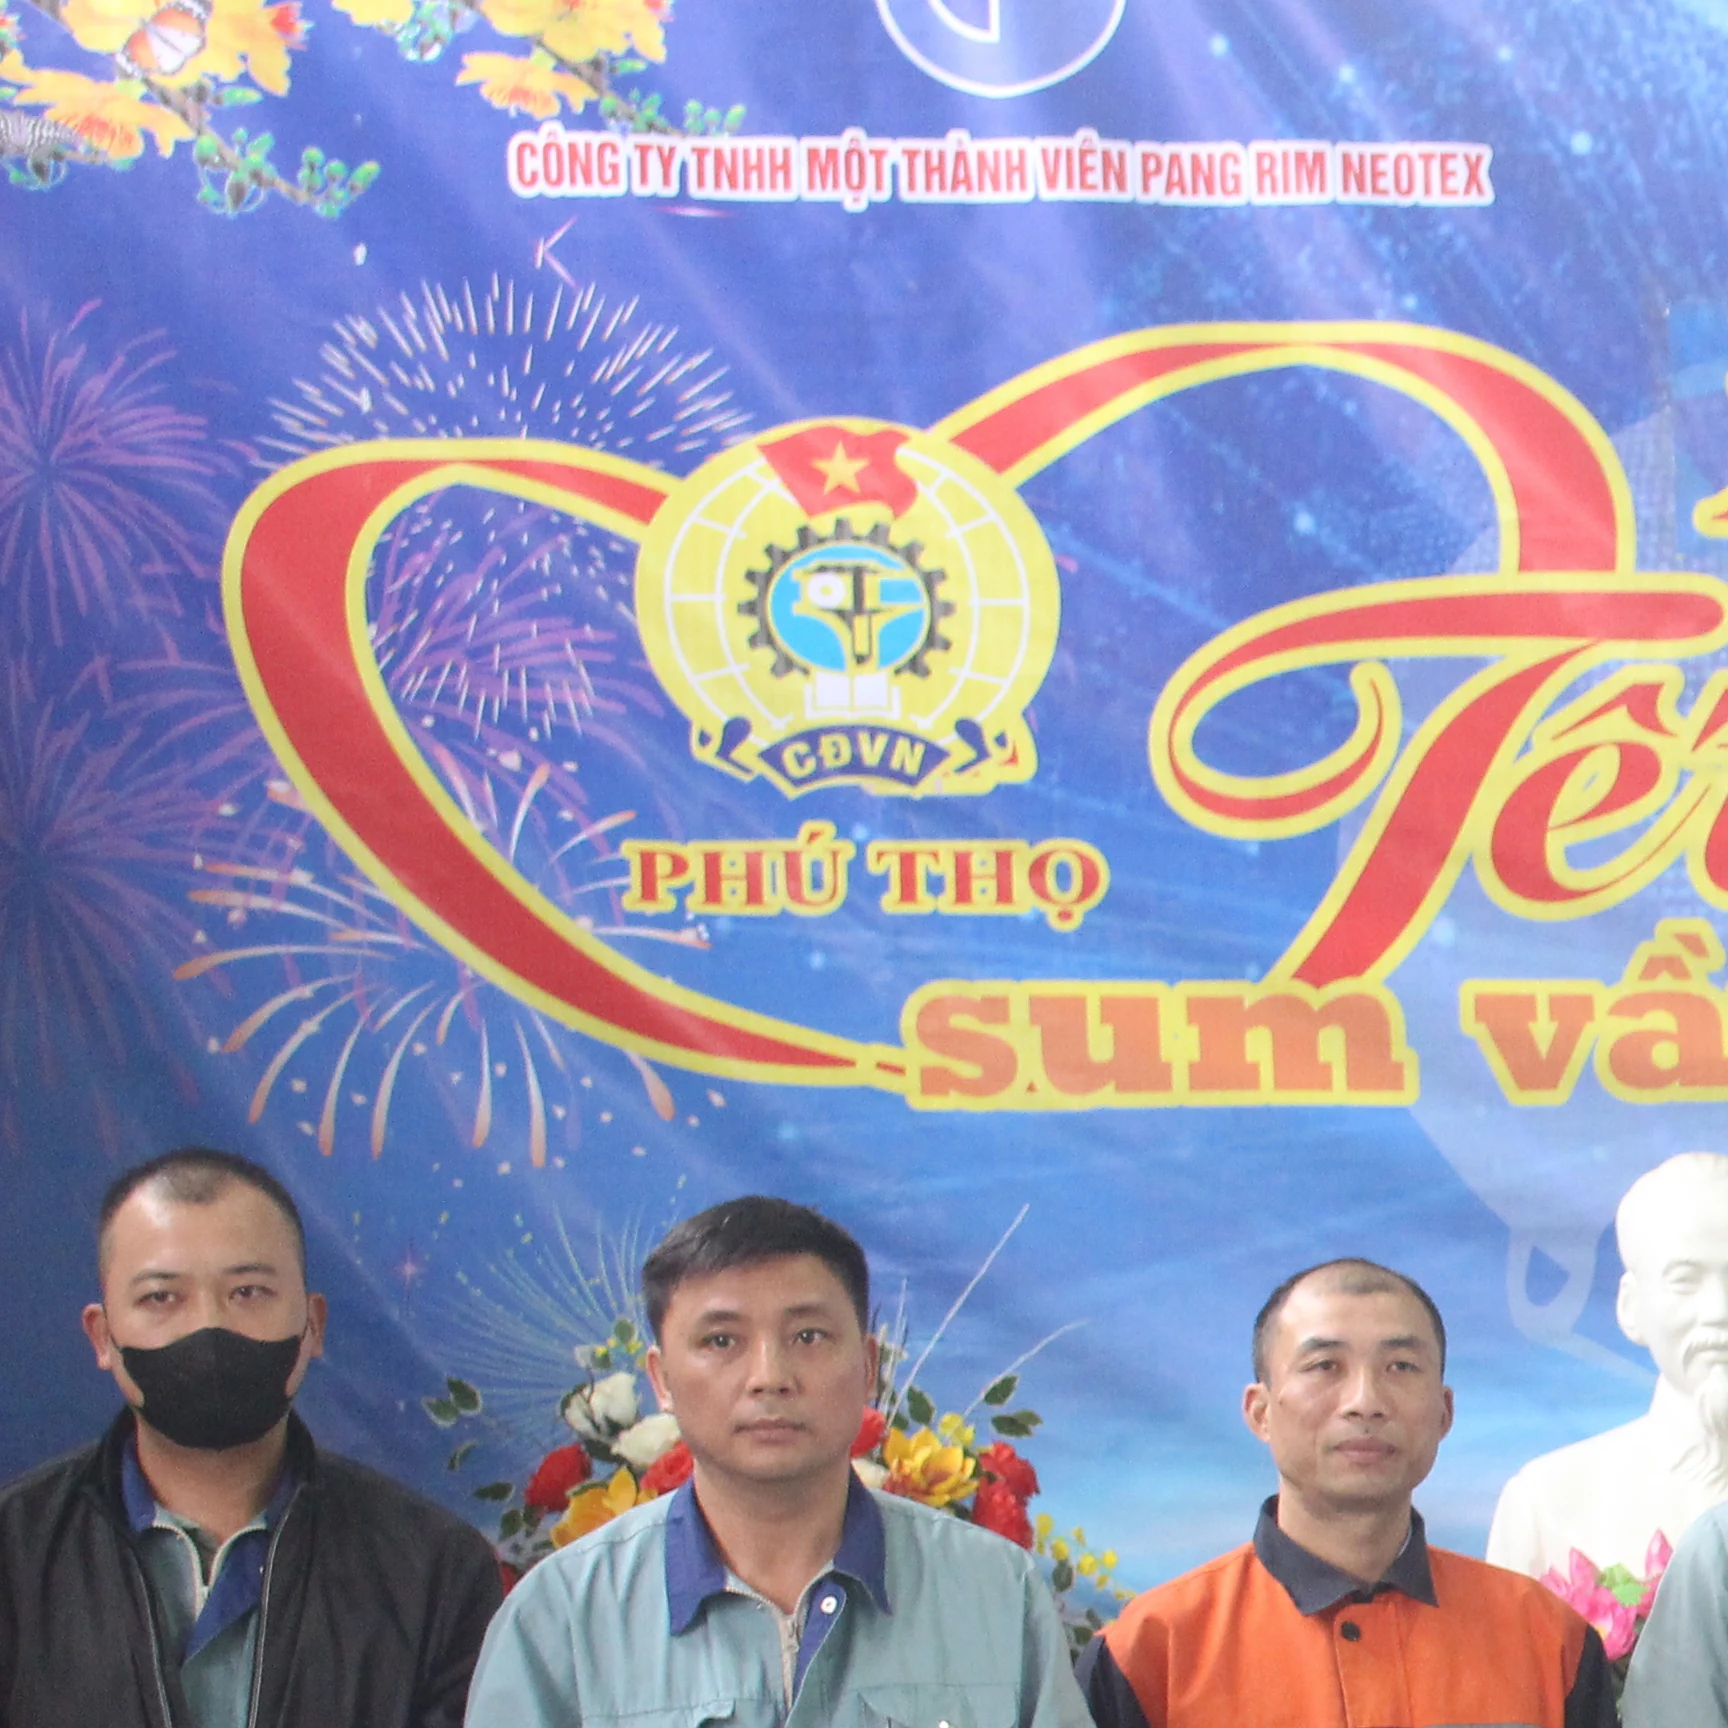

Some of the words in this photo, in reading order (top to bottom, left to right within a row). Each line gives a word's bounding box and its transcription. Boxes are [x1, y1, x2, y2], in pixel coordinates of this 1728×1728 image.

[512, 131, 622, 190] CÔNG
[631, 142, 679, 189] TY
[689, 143, 795, 193] TNHH
[804, 135, 890, 205] MỘT
[899, 136, 1028, 196] THÀNH
[1038, 135, 1129, 194] VIÊN
[1139, 149, 1244, 198] PANG
[1254, 148, 1329, 198] RIM
[1340, 149, 1487, 199] NEOTEX
[782, 731, 926, 779] CĐVN
[626, 823, 852, 912] PHÚ
[870, 842, 1107, 929] THỌ
[906, 984, 1413, 1104] sum
